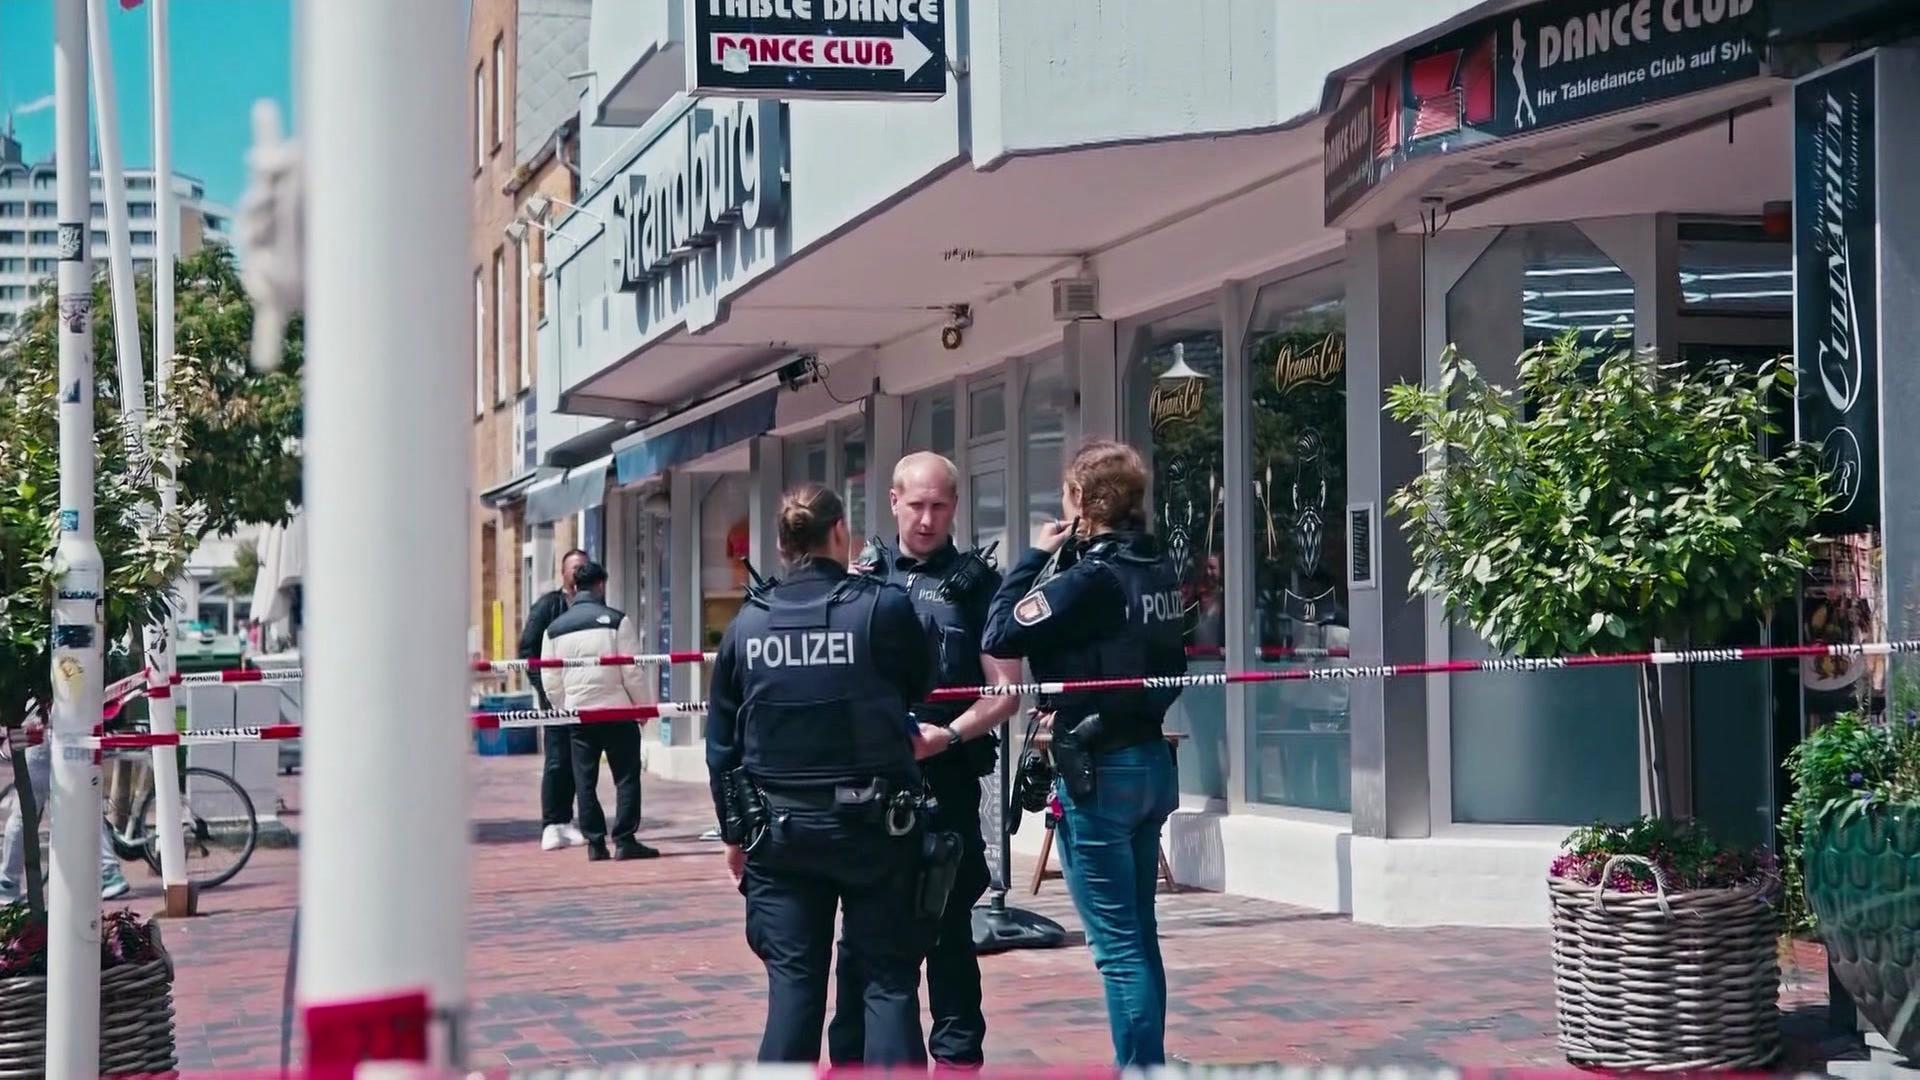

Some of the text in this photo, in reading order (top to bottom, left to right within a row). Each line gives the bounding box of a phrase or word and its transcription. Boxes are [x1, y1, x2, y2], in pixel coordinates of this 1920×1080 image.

[824, 40, 894, 65] CLUB
[1539, 0, 1651, 68] DANCE
[1537, 90, 1557, 107] Ihr
[1561, 67, 1646, 100] Tabledance
[1650, 53, 1685, 78] Club
[1690, 45, 1716, 68] auf
[1351, 105, 1369, 153] CLUB
[611, 99, 760, 293] Strandburg
[1818, 90, 1850, 413] CULINARIUM
[747, 632, 854, 670] POLIZEI
